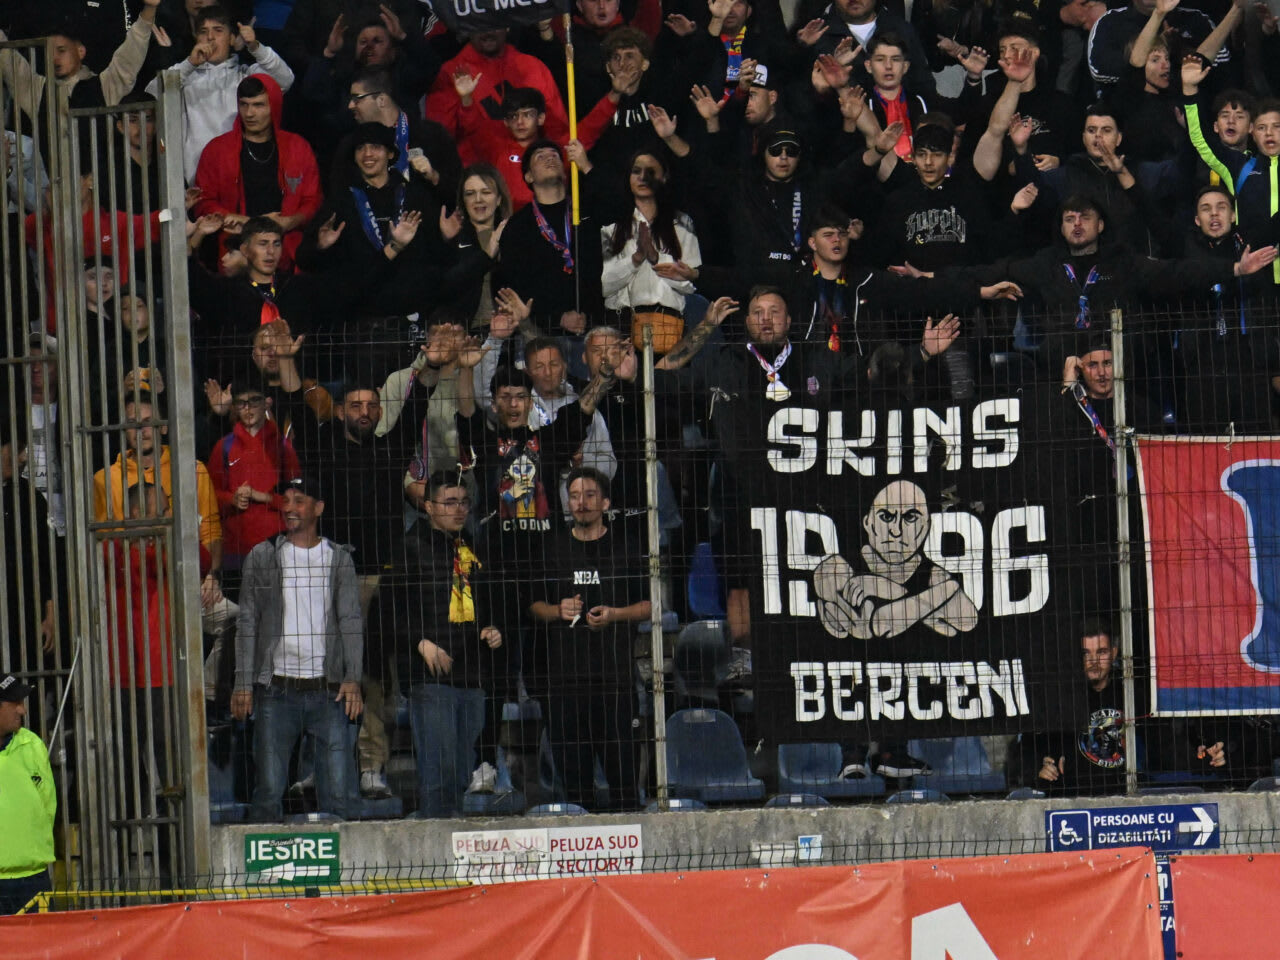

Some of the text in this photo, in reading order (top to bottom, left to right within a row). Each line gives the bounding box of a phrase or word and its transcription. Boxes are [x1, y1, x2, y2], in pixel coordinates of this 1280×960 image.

[767, 397, 1021, 477] SKINS
[573, 571, 600, 585] NBA
[790, 658, 1031, 723] BERCENI
[1093, 813, 1175, 827] PERSOANE CU
[550, 835, 639, 853] PELUZA SUD
